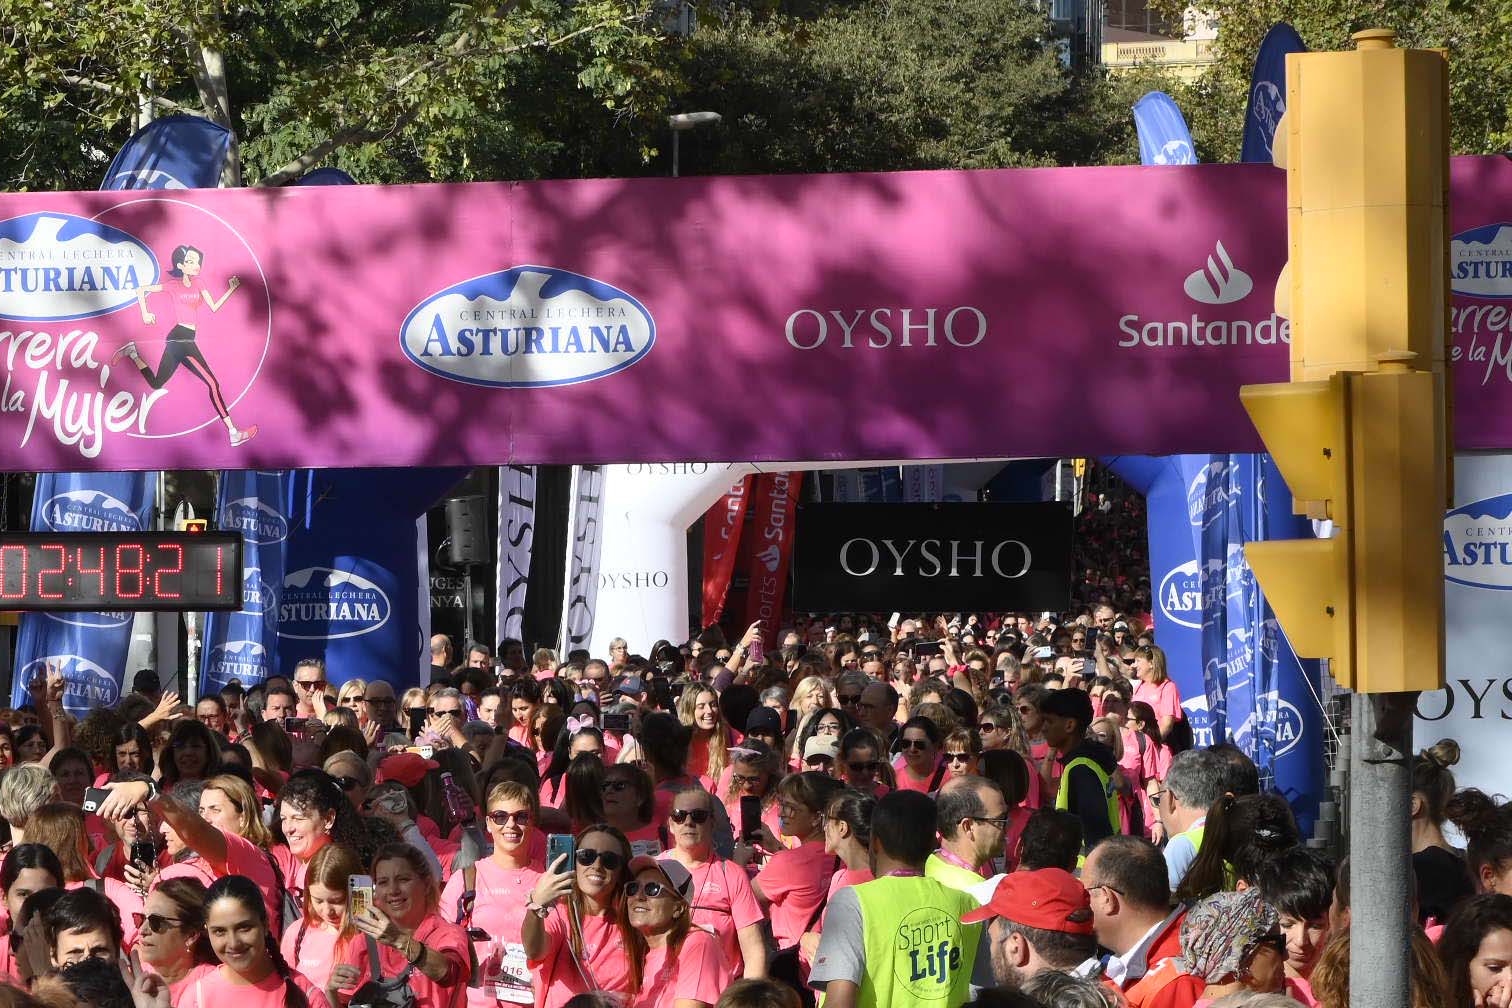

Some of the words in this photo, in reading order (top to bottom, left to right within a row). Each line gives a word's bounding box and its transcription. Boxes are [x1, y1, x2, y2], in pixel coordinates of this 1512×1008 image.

[63, 248, 135, 260] LECHERA
[1450, 259, 1512, 280] STUR
[459, 308, 537, 322] CENTRAL
[545, 306, 626, 320] LECHERA
[785, 306, 987, 350] OYSHO
[419, 313, 635, 357] ASTURIANA
[1468, 337, 1486, 361] la
[1483, 333, 1512, 385] M
[1, 370, 25, 412] la
[21, 365, 168, 458] Mujer
[0, 544, 223, 600] 02:48:21
[840, 538, 1033, 579] OYSHO
[278, 602, 381, 622] STURIANA
[328, 592, 376, 600] LECHERA
[899, 916, 953, 950] Sport
[910, 941, 961, 984] Life
